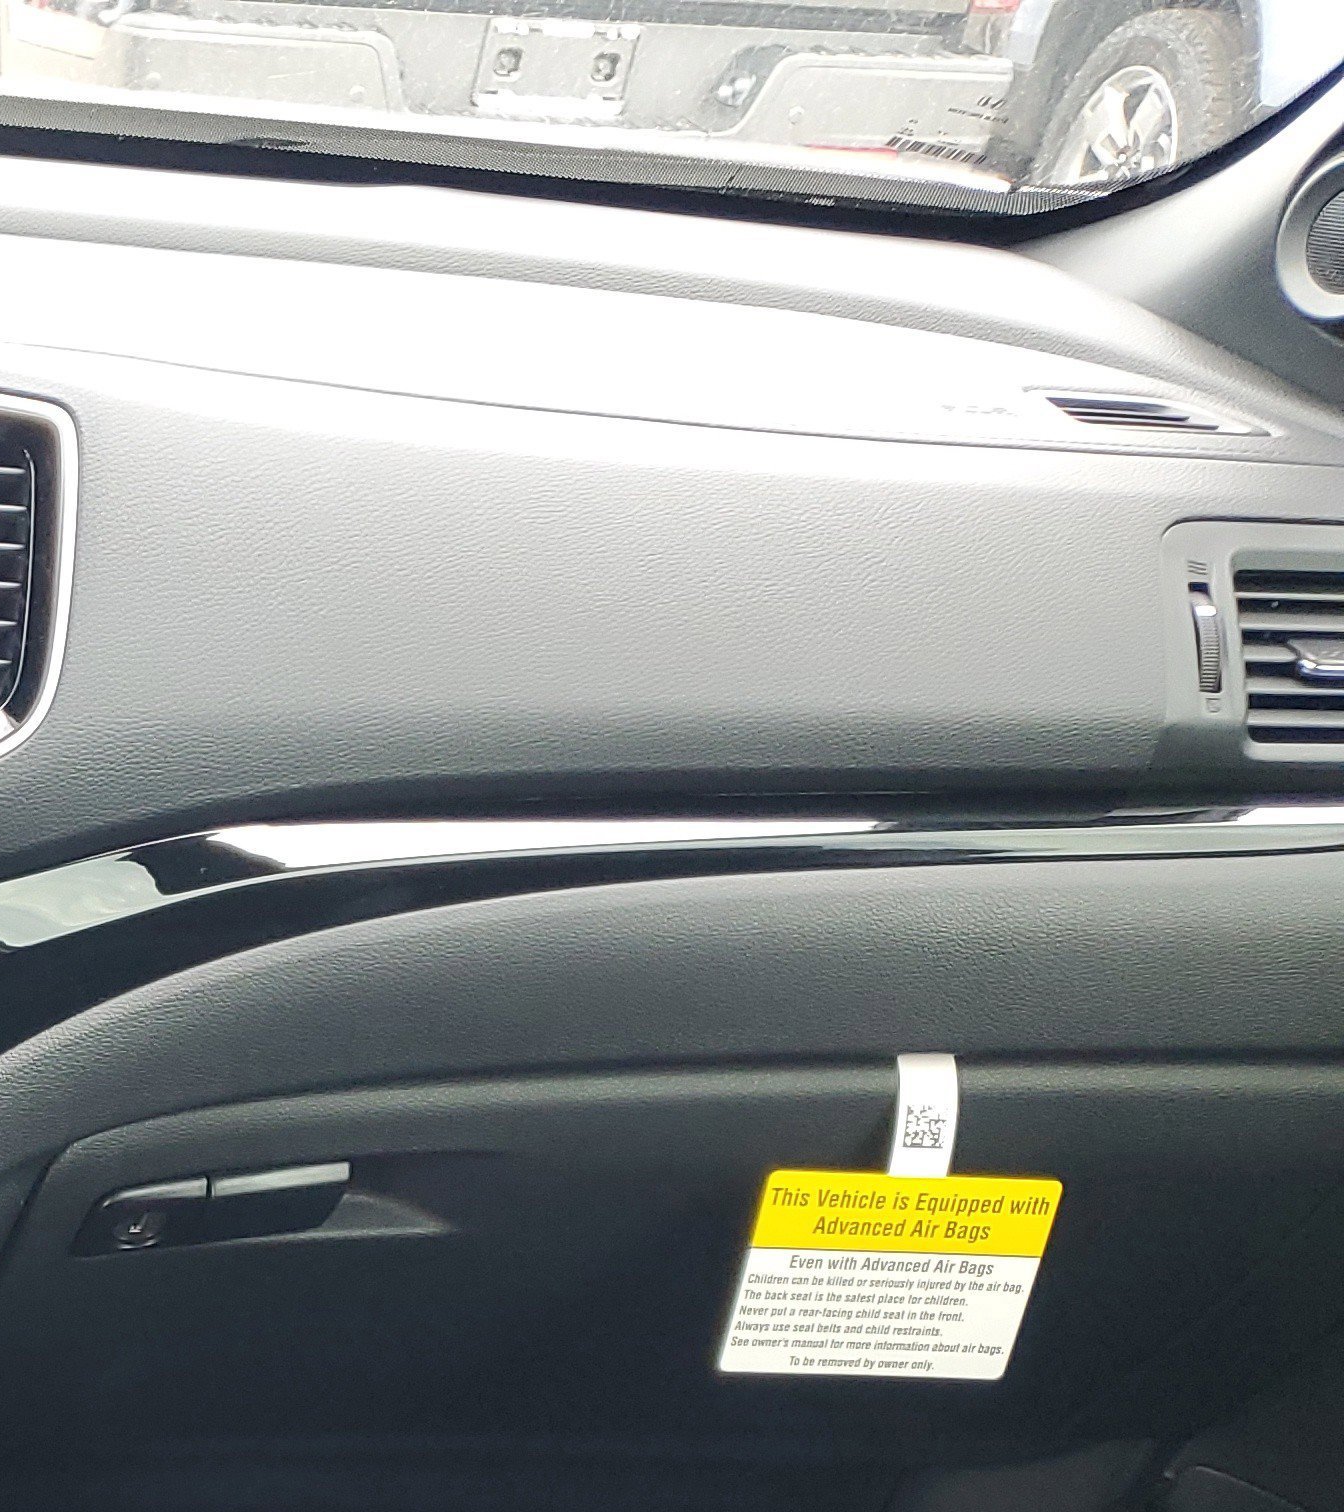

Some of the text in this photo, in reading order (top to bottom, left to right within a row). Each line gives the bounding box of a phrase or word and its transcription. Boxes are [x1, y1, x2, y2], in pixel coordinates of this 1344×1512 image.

[770, 1187, 1050, 1217] This Vehicle is Equipped with
[812, 1216, 991, 1244] Advanced Air Bags
[789, 1254, 994, 1278] Even with Advanced Air Bags
[748, 1274, 1024, 1294] Children can be killed or seriously injured by the air bag.
[744, 1290, 968, 1306] The back seat is the safest place for children.
[739, 1305, 964, 1322] Never put a rear-facing child seat in the front.
[734, 1320, 943, 1337] Always use seat belts and child restraints.
[730, 1336, 1004, 1356] See owner's manual for more information about air bags.
[789, 1356, 934, 1372] To be removed by owner only.
